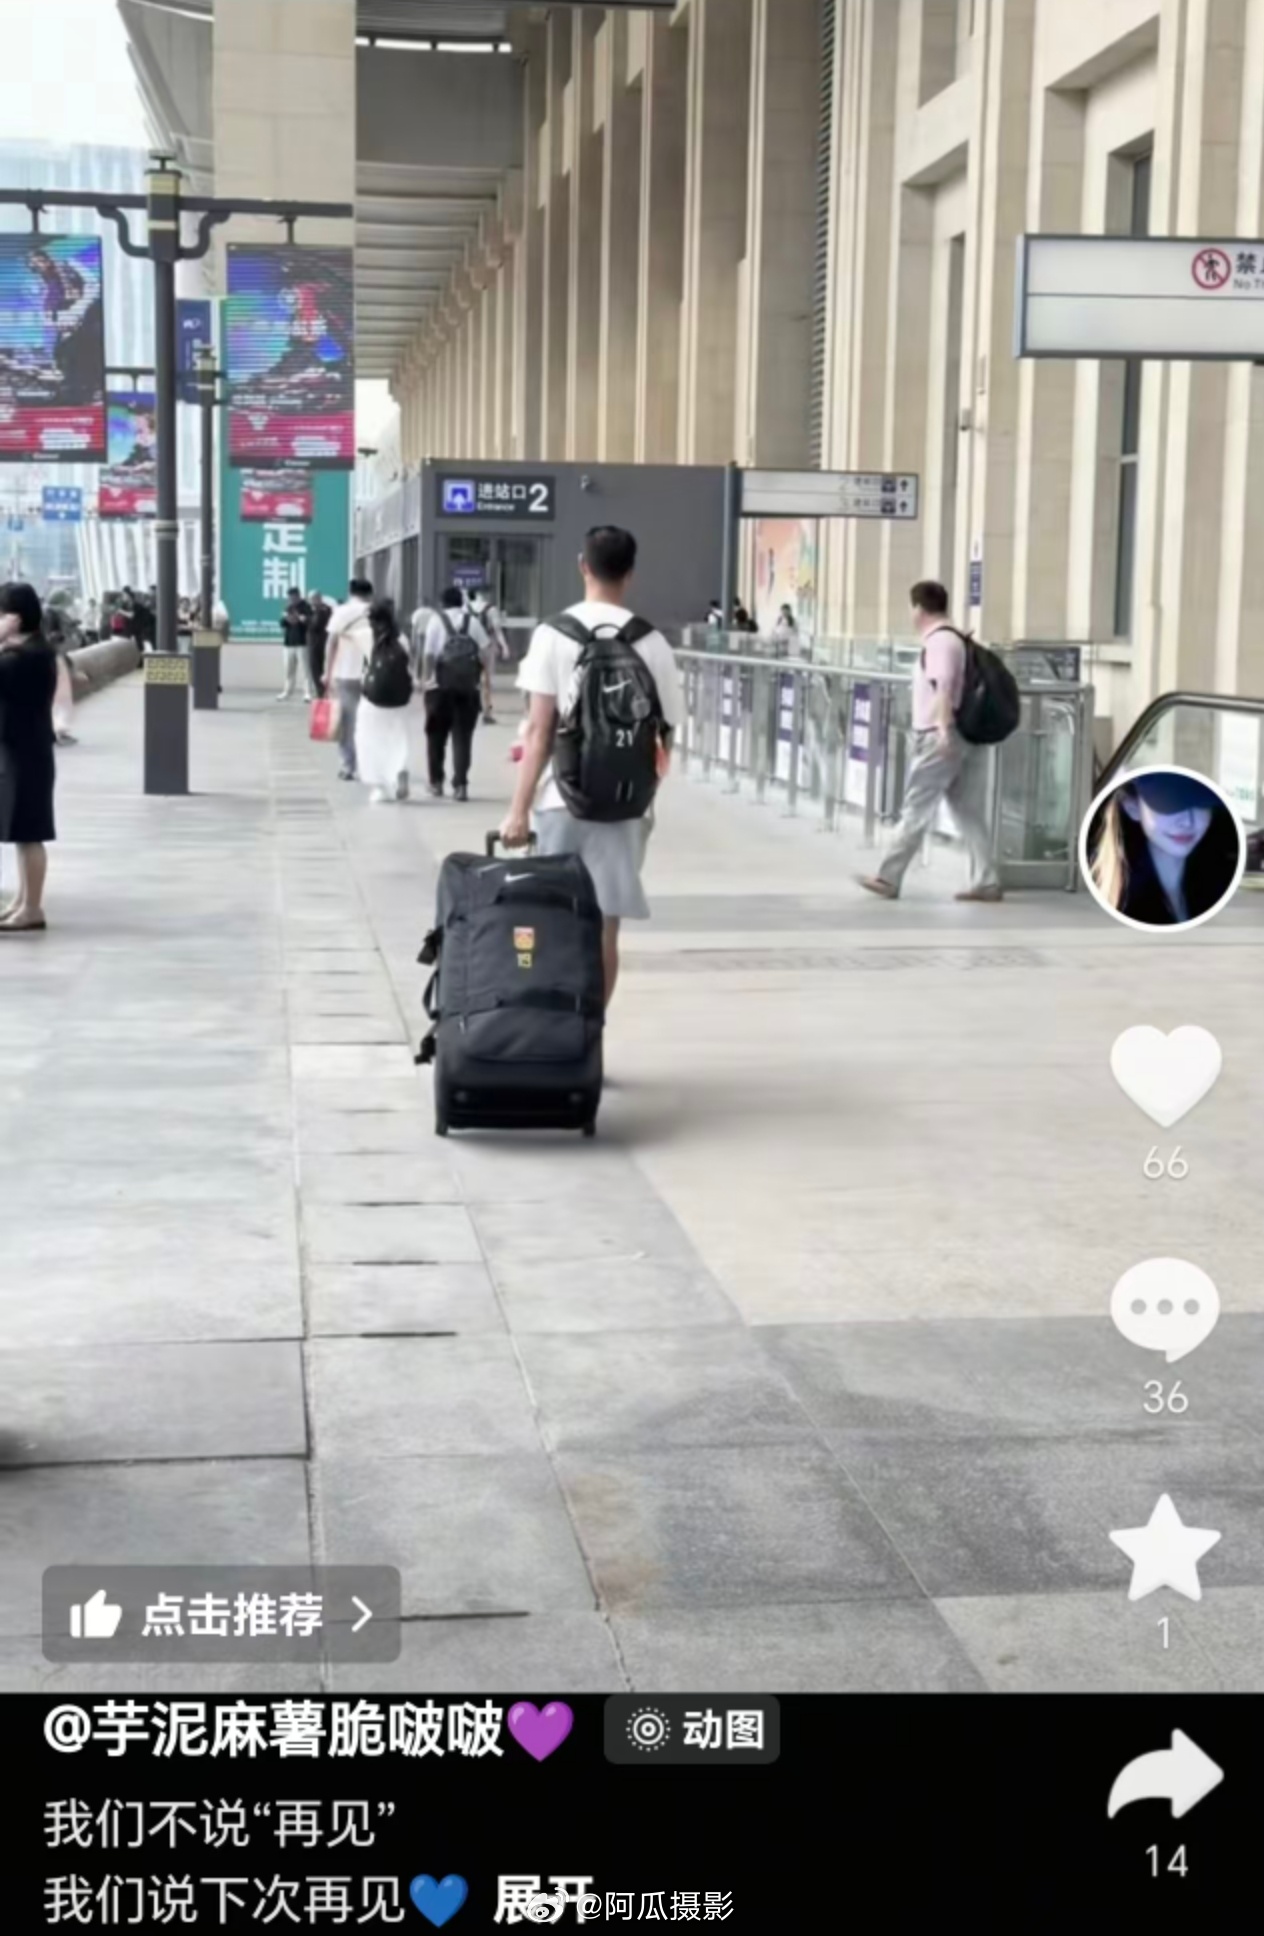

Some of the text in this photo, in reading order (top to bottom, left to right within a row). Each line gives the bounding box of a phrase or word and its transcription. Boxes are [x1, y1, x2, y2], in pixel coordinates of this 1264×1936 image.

[477, 483, 527, 499] 进站口
[529, 483, 549, 512] 2
[477, 501, 515, 512] Entrance
[615, 728, 633, 748] 21
